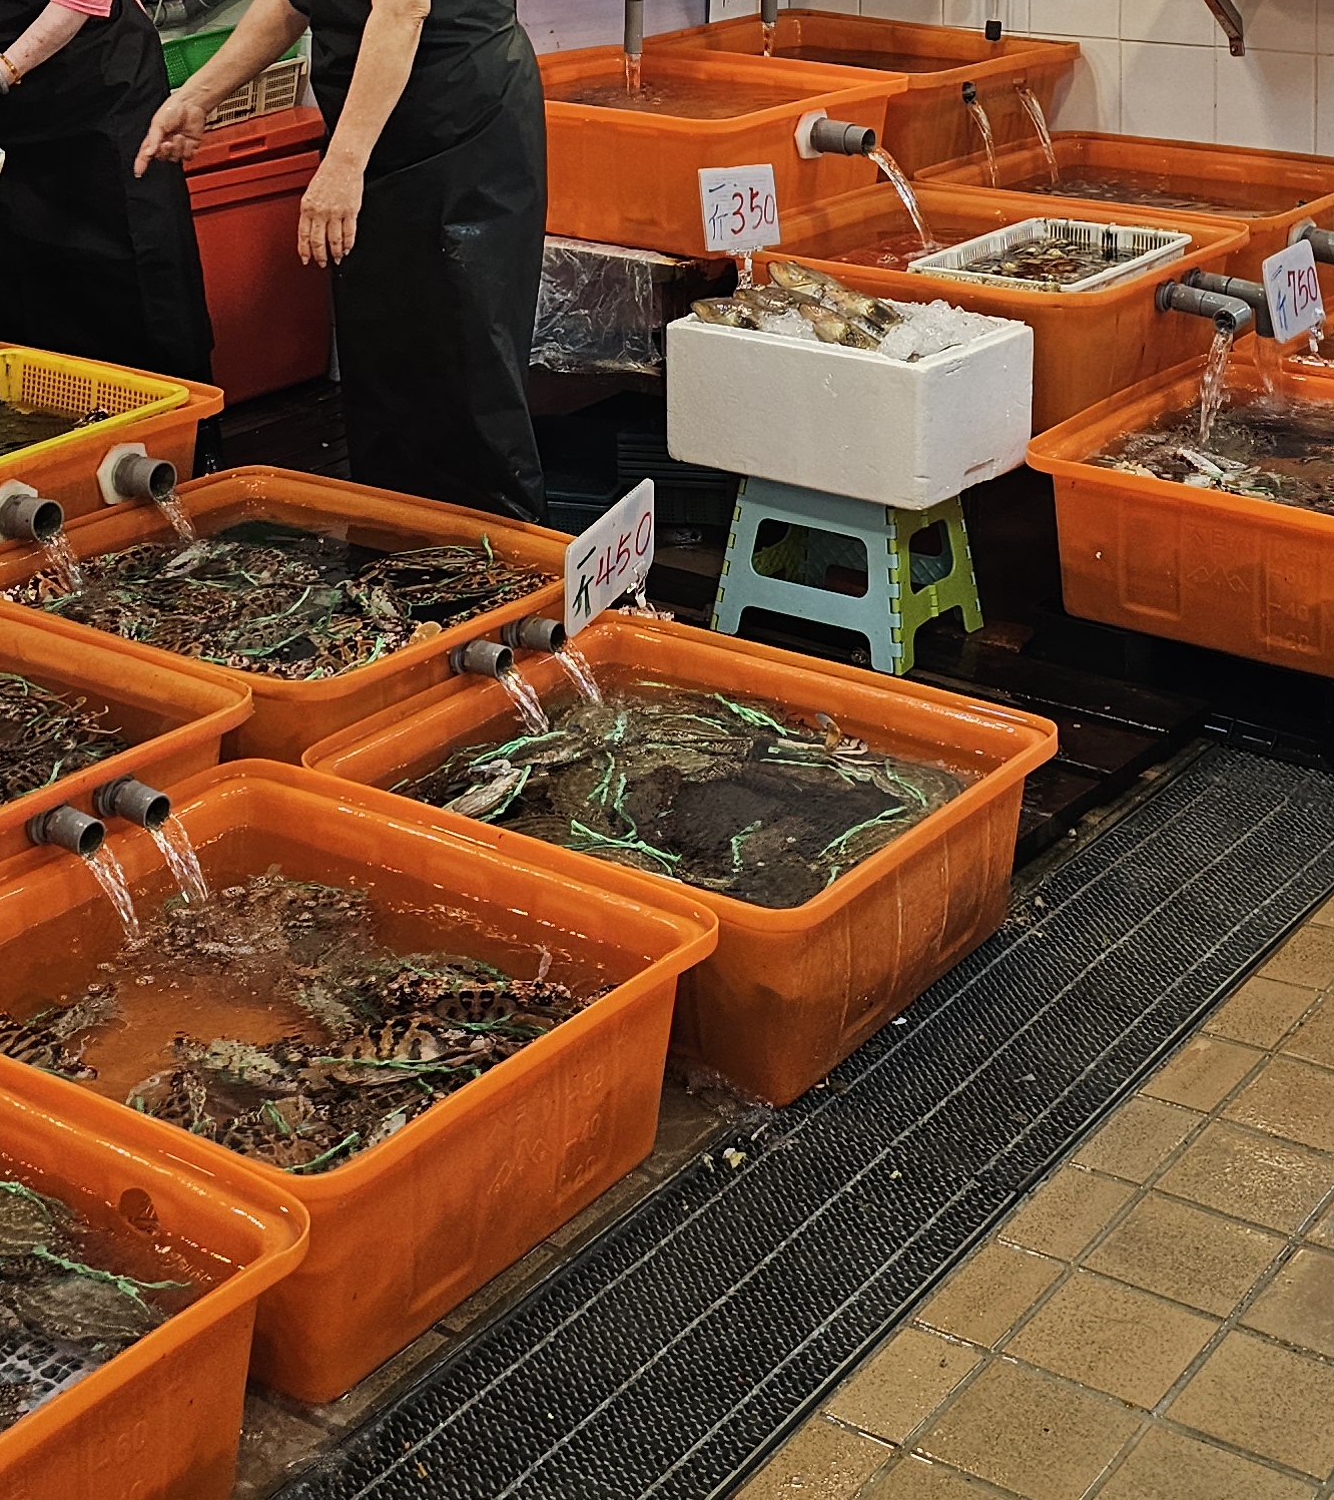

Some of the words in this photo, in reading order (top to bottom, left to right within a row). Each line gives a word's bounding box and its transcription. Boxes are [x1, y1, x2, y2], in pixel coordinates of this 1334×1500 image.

[730, 187, 776, 235] 350
[1287, 266, 1318, 317] 750
[595, 511, 652, 587] 450
